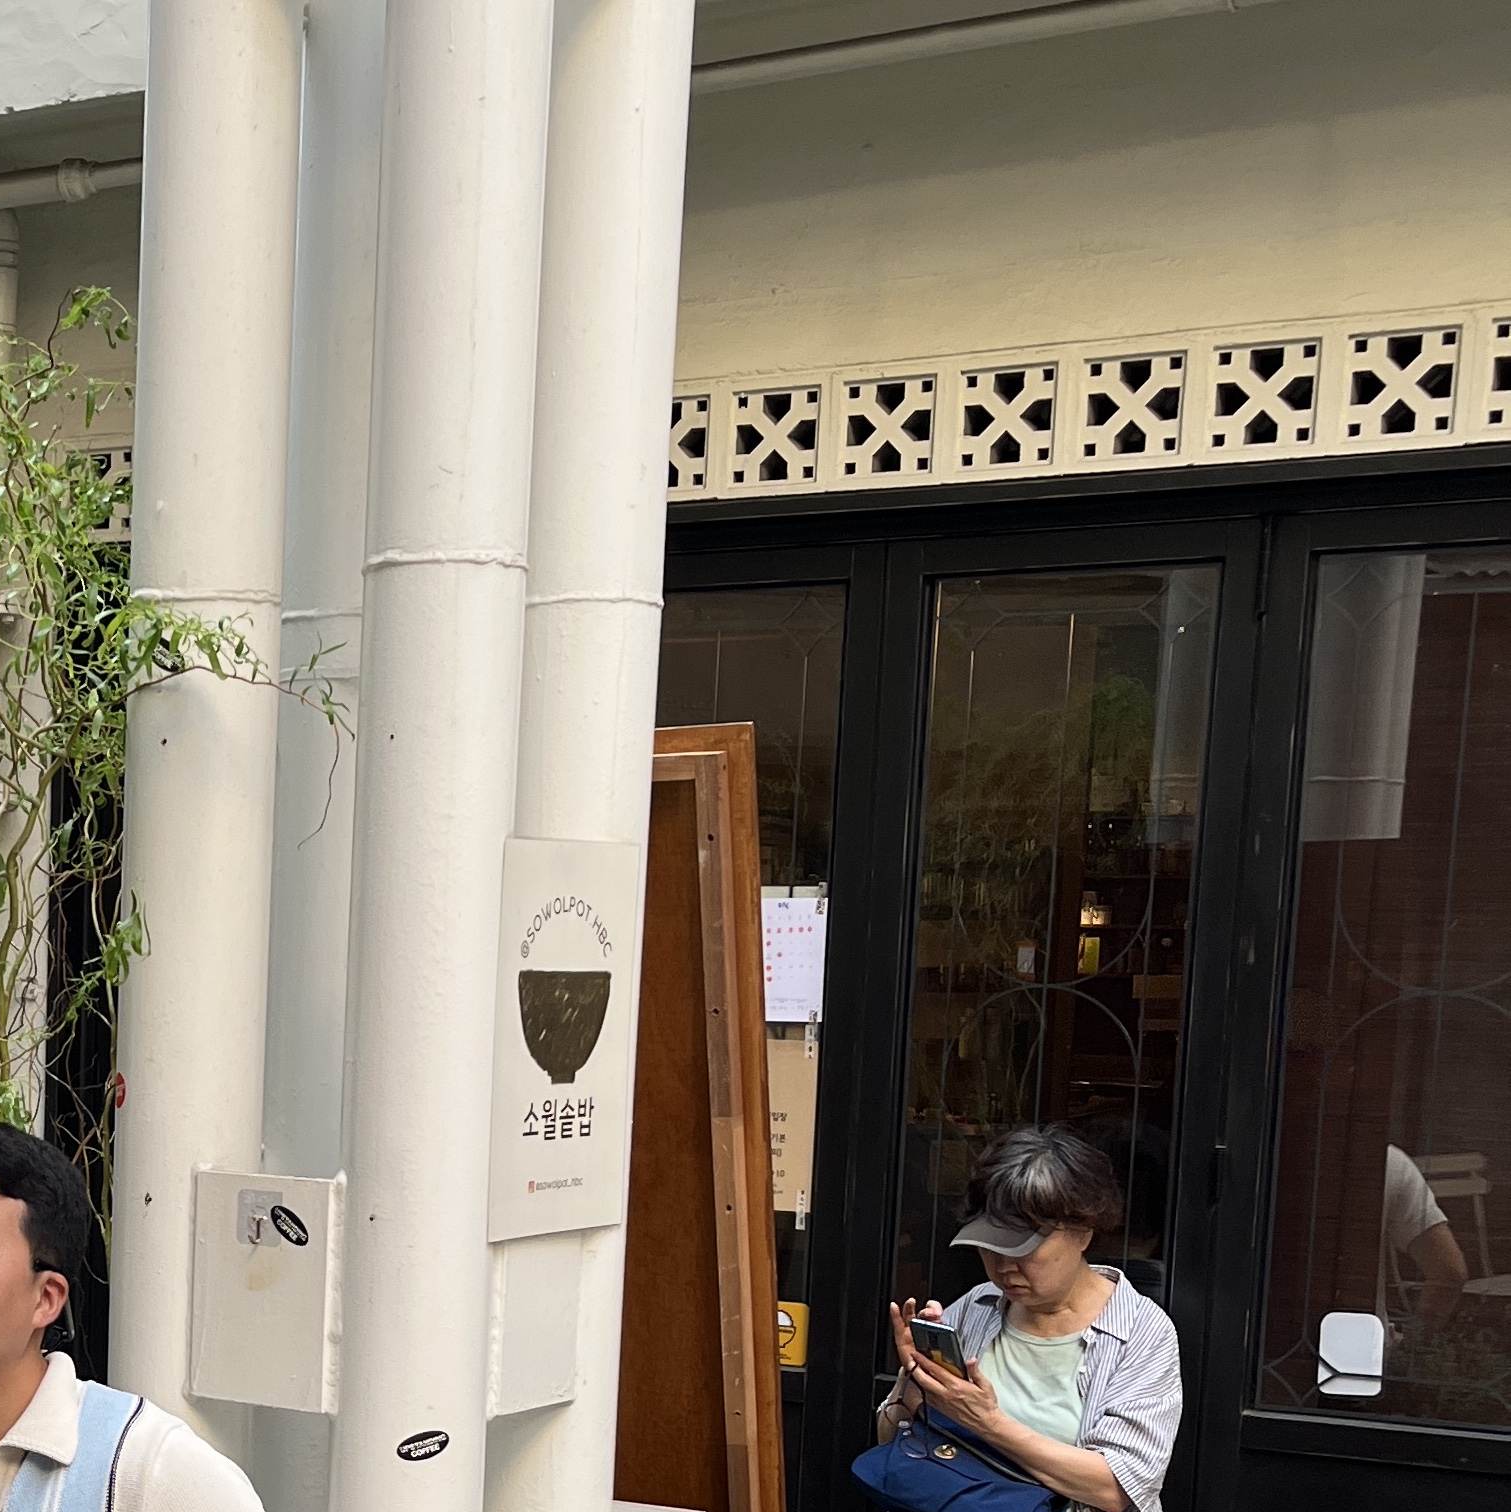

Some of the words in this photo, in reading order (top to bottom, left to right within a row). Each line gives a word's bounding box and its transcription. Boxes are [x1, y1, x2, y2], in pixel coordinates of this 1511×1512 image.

[522, 1096, 595, 1141] 소월솥밥
[276, 1218, 299, 1242] COFFEE
[410, 1442, 440, 1458] COFFEE
